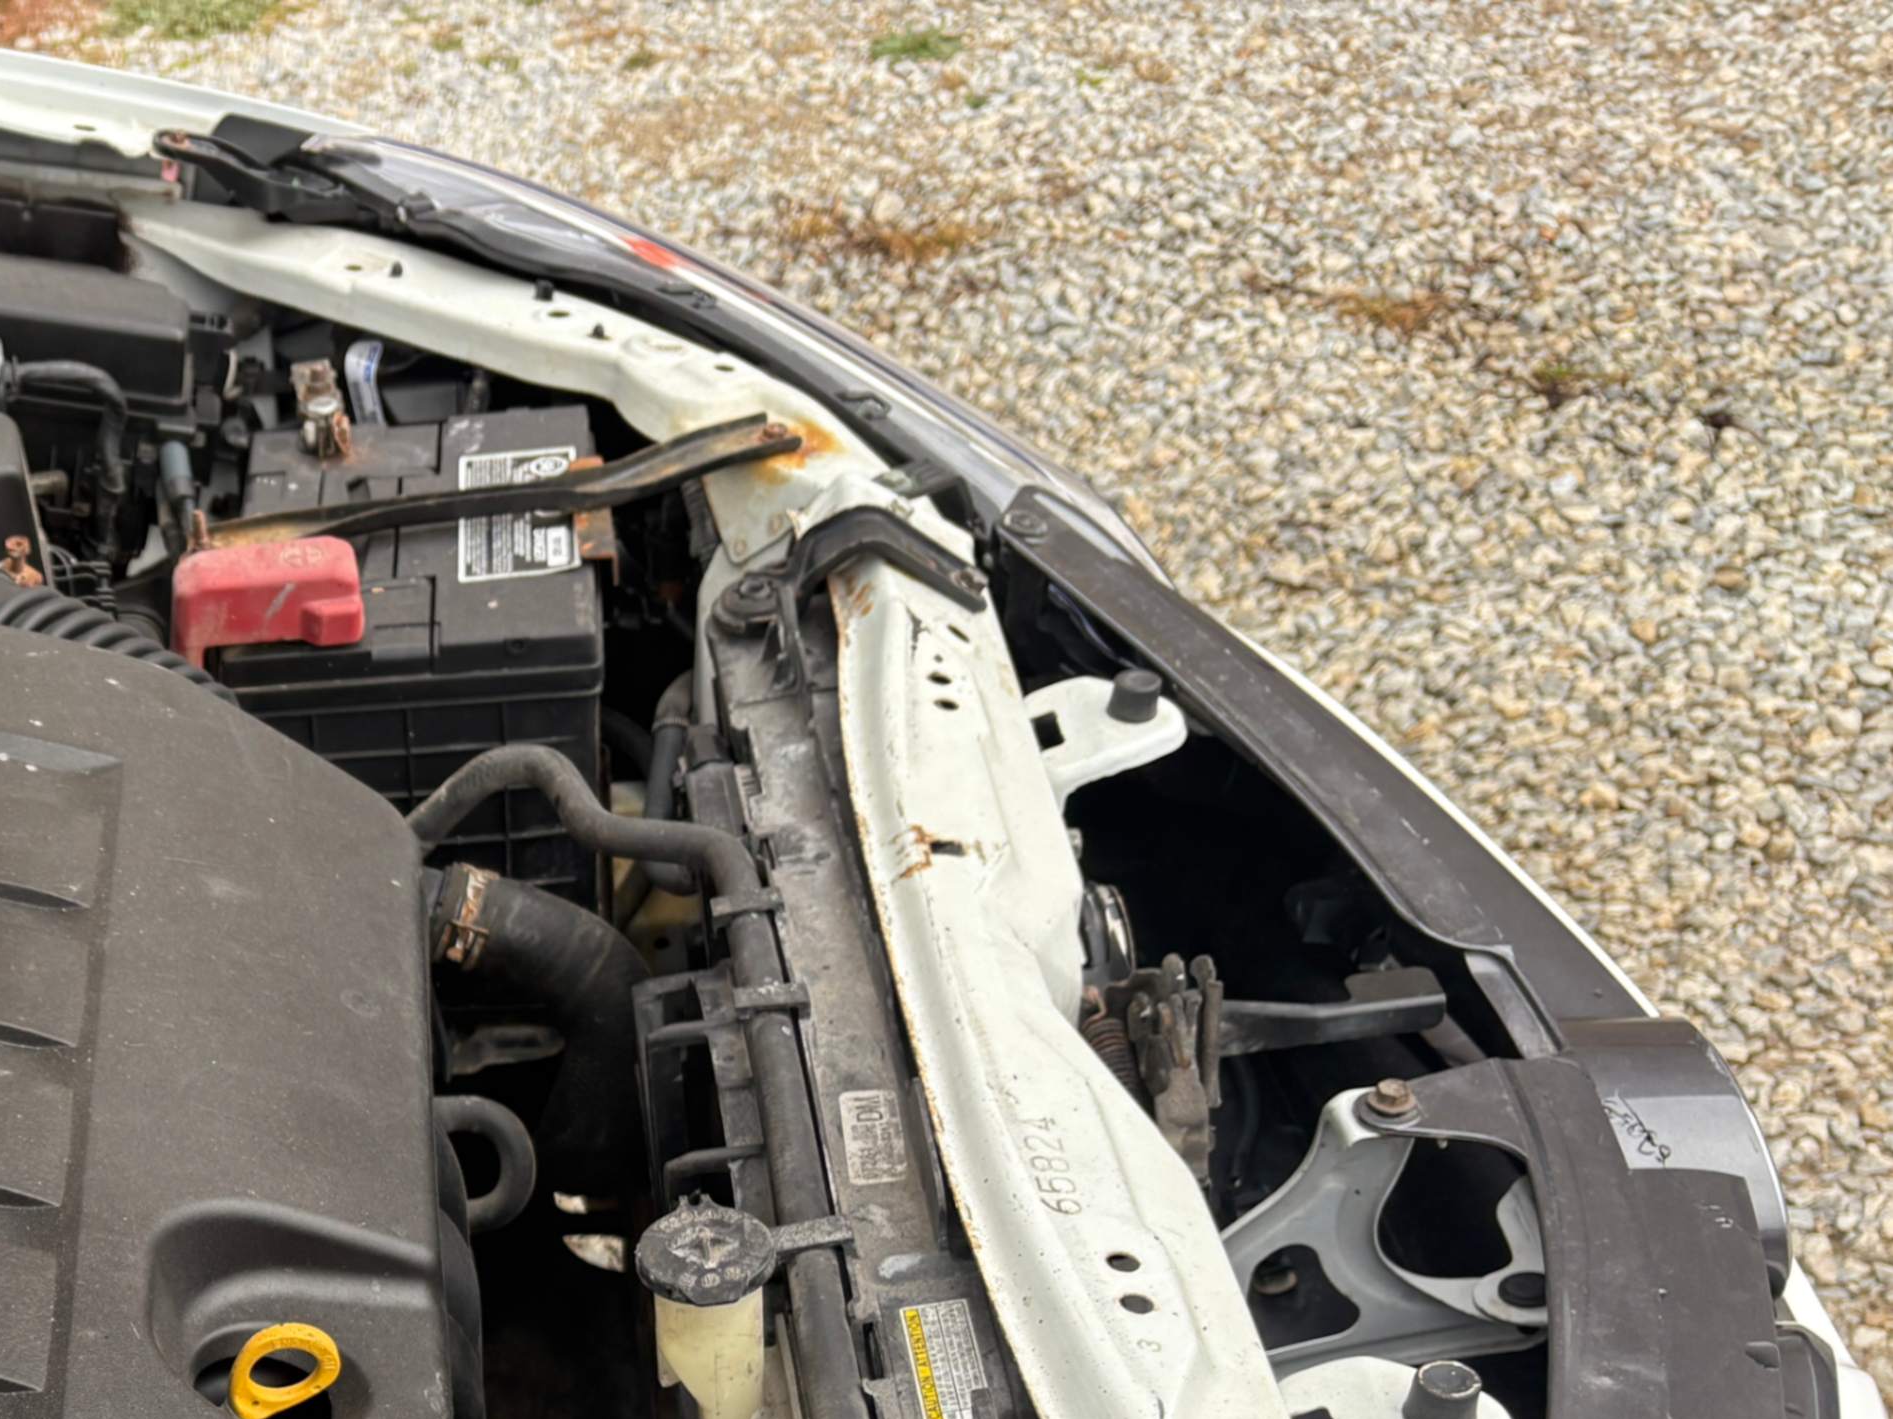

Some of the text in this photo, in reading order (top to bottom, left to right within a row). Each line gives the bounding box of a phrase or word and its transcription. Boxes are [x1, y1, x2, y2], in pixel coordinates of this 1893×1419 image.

[1016, 1116, 1083, 1216] 65824
[909, 1314, 939, 1419] CAUTION ATTENTION
